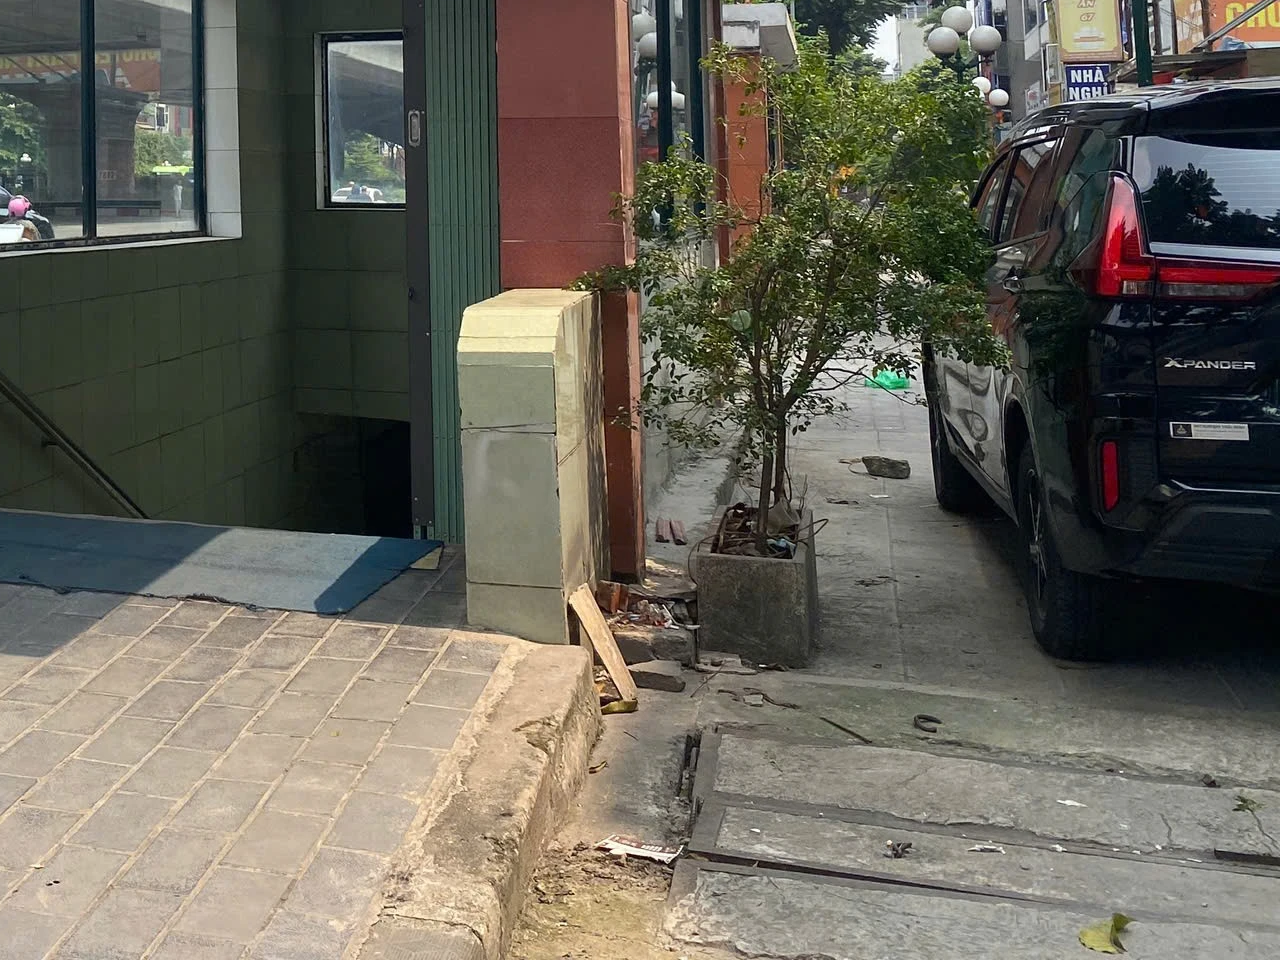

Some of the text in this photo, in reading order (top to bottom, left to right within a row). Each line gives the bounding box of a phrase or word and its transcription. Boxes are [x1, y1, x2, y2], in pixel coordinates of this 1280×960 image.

[1080, 11, 1096, 22] 67
[1070, 67, 1105, 83] NHÀ
[1164, 357, 1256, 370] XPANDER
